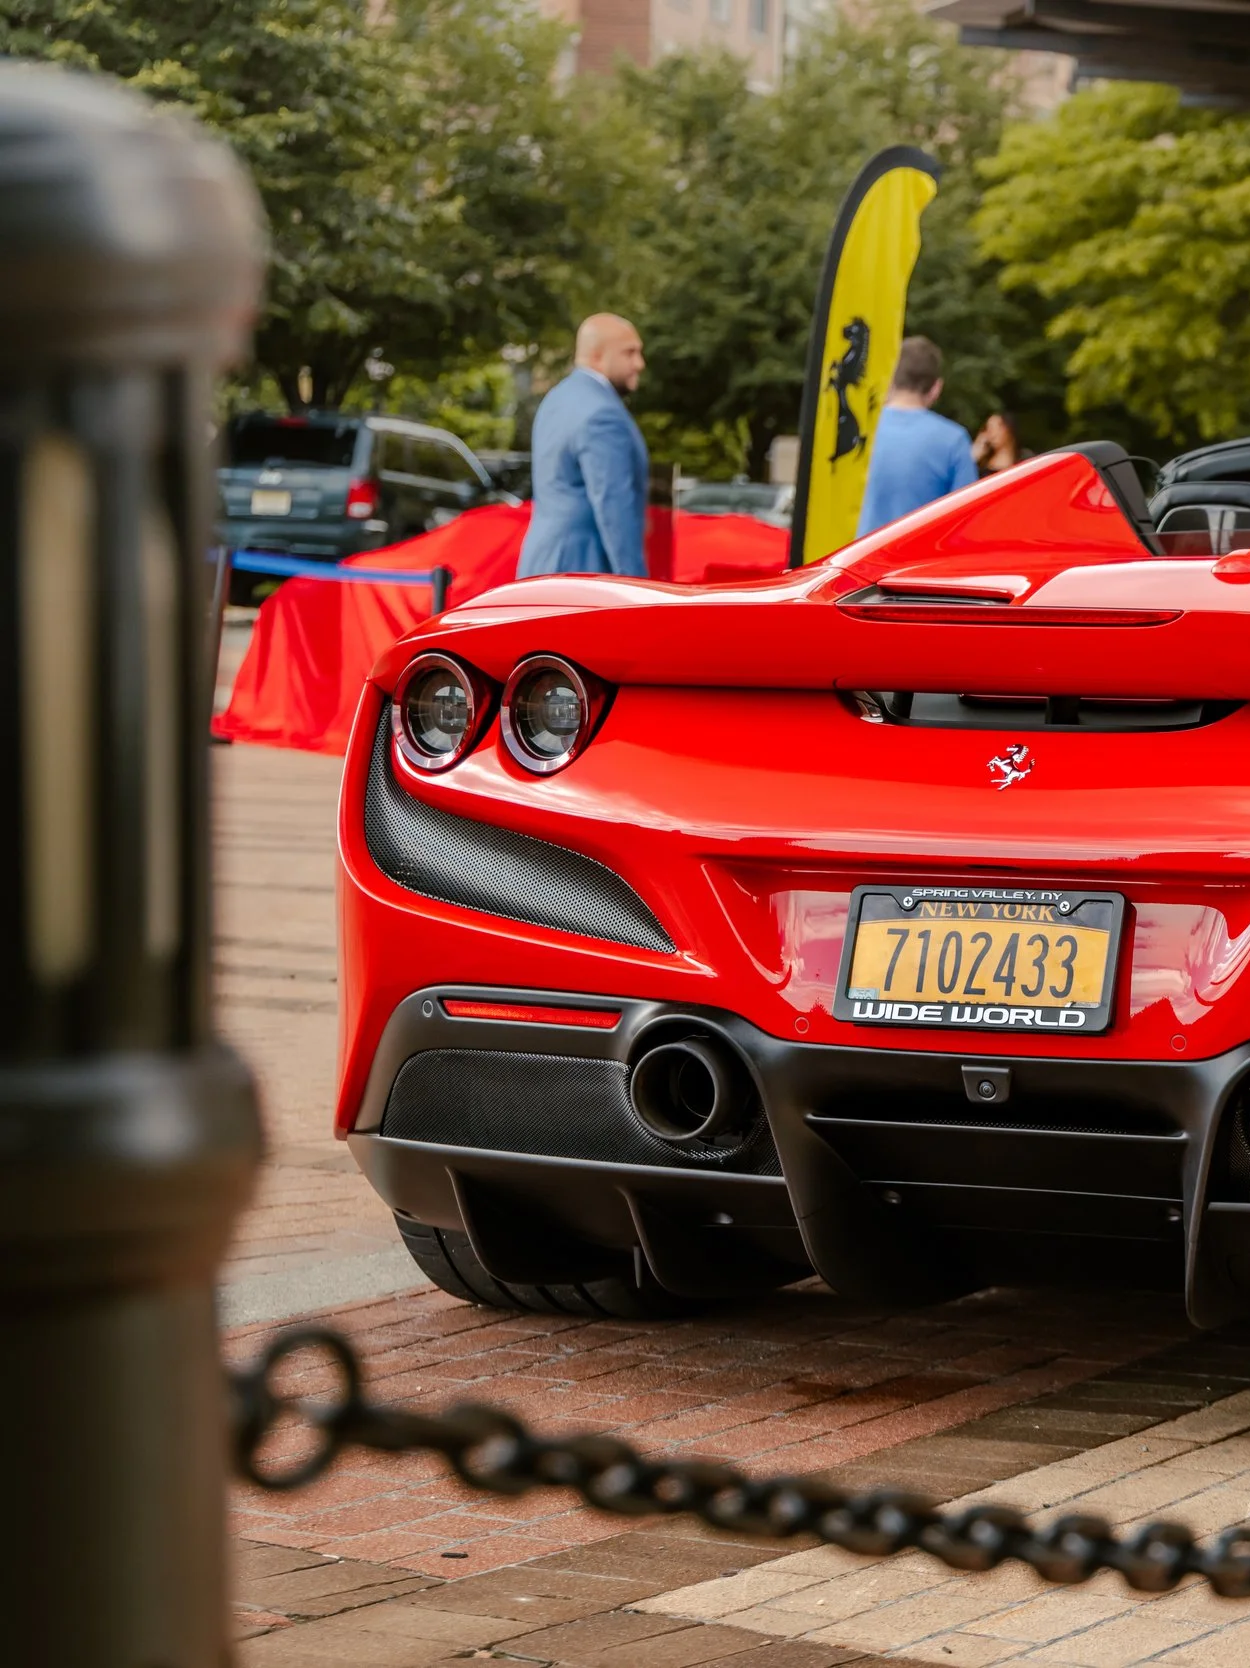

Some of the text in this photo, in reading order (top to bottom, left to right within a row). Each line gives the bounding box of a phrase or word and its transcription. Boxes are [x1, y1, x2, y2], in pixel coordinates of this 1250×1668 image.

[912, 888, 968, 897] SPRING
[1041, 892, 1063, 900] NY
[920, 901, 1055, 922] NEW YORK
[883, 928, 1078, 998] 7102433
[853, 1002, 1086, 1027] WIDE WORLD
